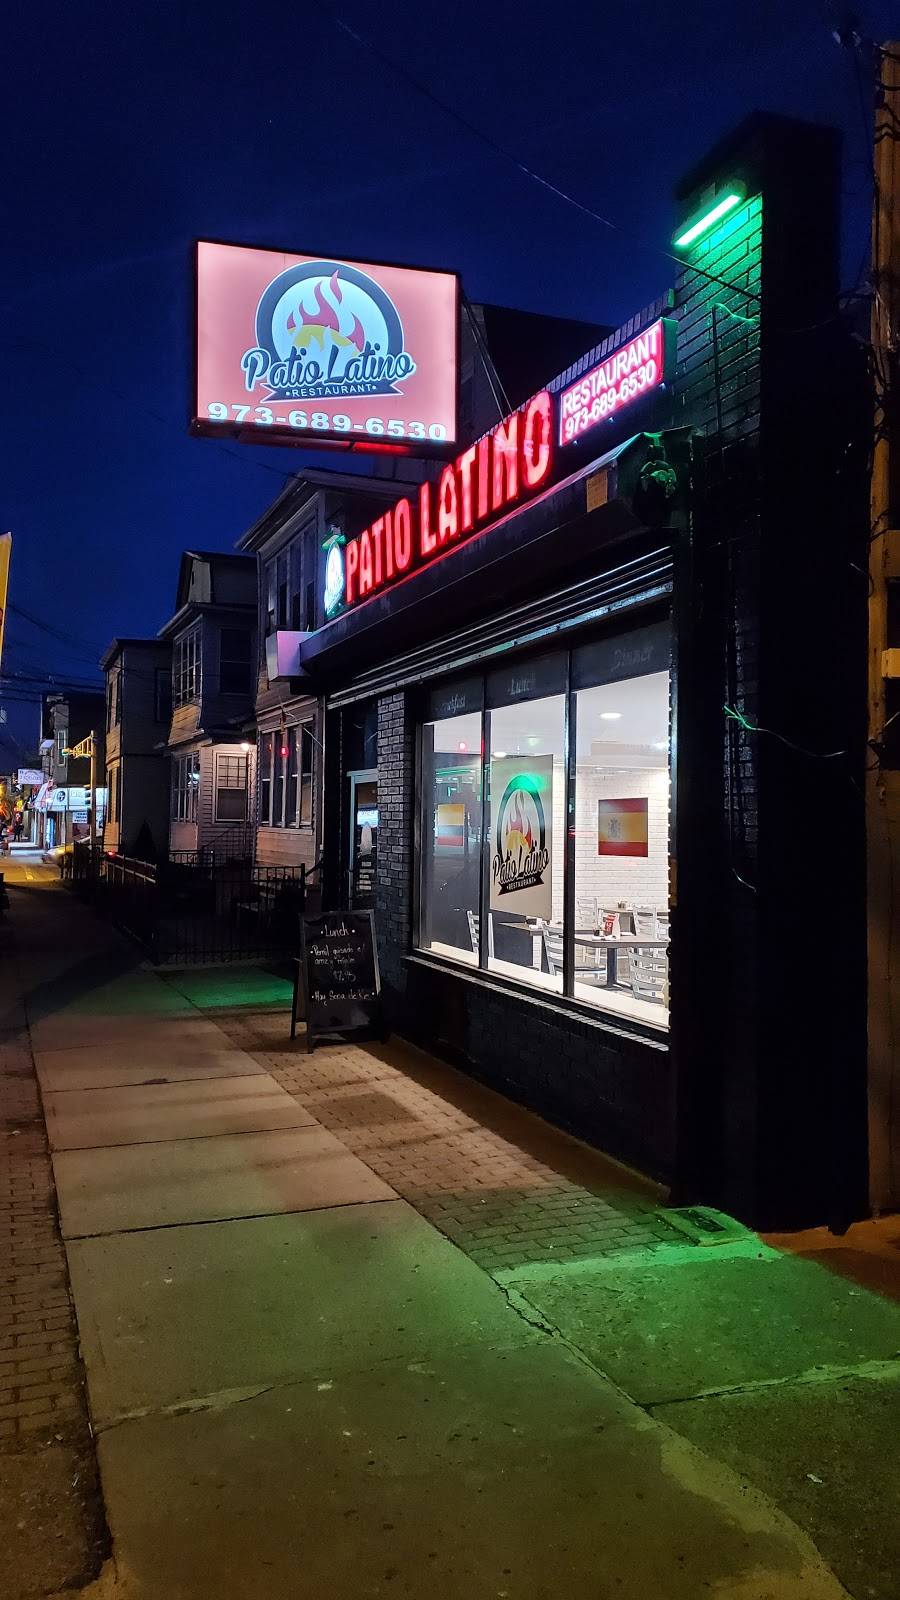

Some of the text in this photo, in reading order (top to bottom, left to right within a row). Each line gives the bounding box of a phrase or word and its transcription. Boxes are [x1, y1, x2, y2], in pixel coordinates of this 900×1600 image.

[242, 342, 415, 390] Patio Latino
[562, 328, 661, 414] RESTAURANT
[292, 383, 372, 398] RESTAURANT
[565, 359, 657, 440] 973-689-6530
[207, 402, 447, 441] 973-689-6530
[344, 391, 553, 606] PATIO LATINO
[493, 839, 550, 886] Patio Latino
[325, 921, 349, 937] Lunch
